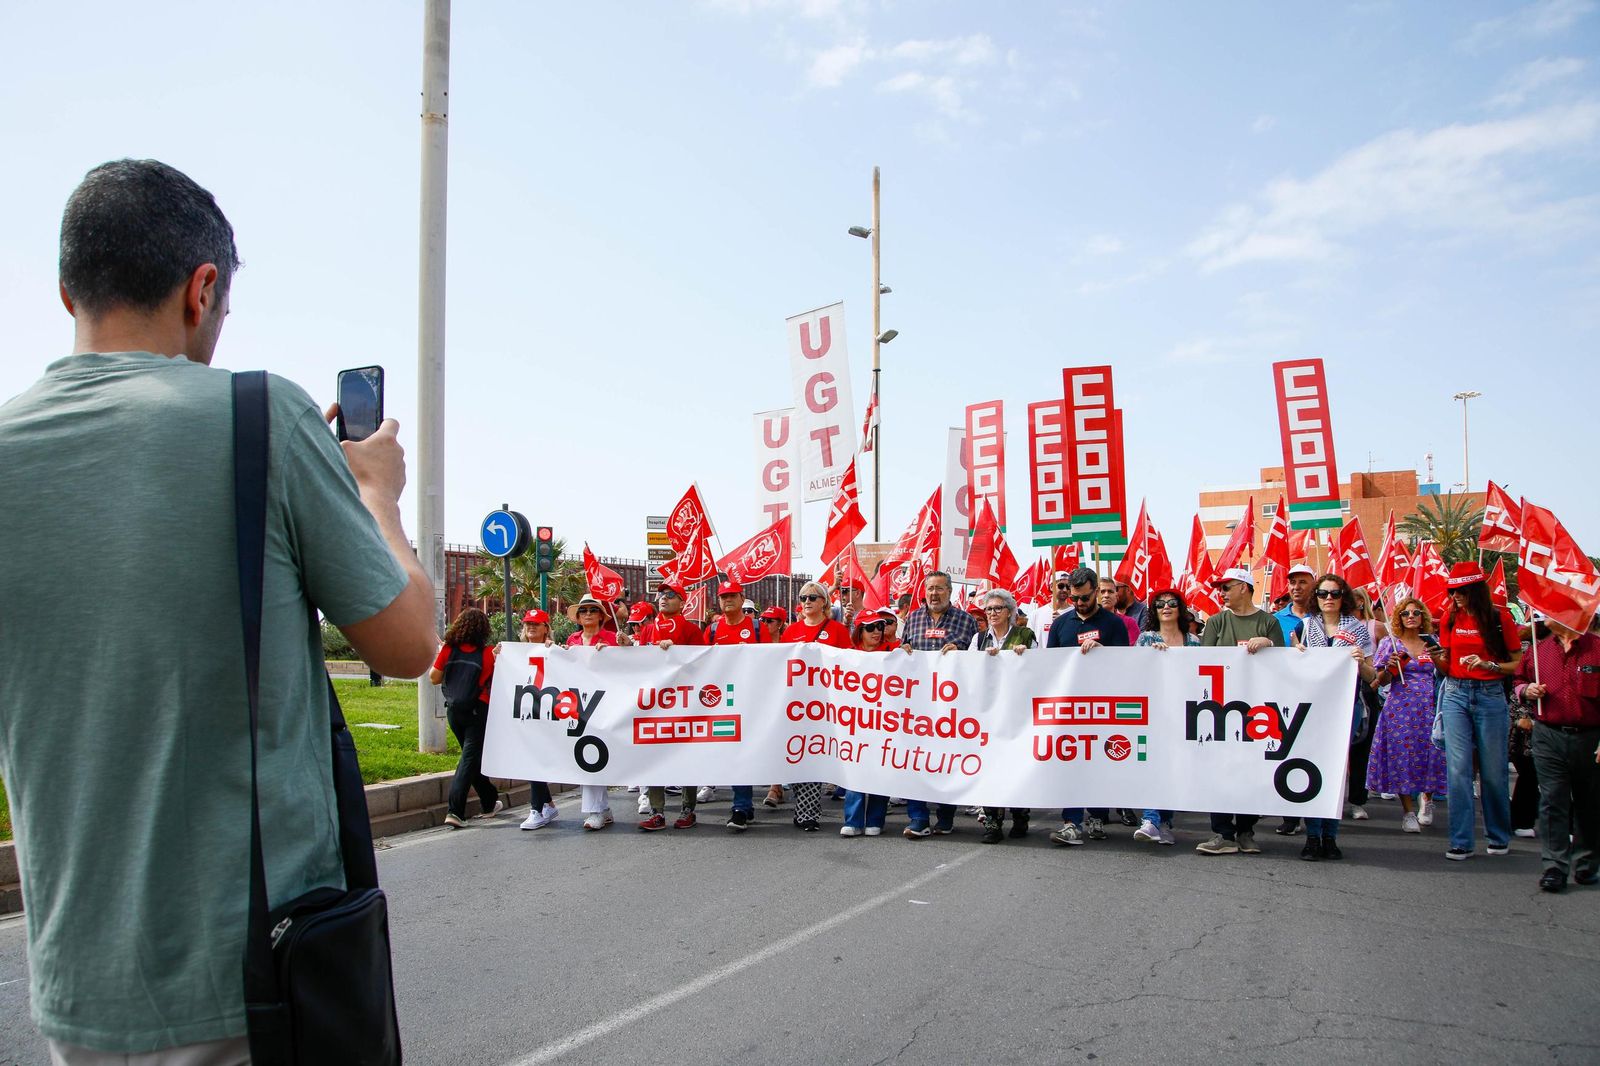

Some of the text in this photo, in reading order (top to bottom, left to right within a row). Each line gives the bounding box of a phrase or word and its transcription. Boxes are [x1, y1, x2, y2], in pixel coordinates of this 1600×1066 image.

[799, 315, 841, 469] UGT
[1072, 373, 1111, 510] CCOO
[1282, 365, 1331, 499] CCOO
[1034, 405, 1065, 521] CCOO
[637, 685, 694, 711] UGT
[786, 658, 959, 703] Proteger lo
[639, 721, 708, 739] CCOO
[786, 700, 990, 747] conquistado,
[1038, 702, 1111, 720] CCOO
[785, 733, 982, 776] ganar futuro
[1032, 734, 1099, 762] UGT
